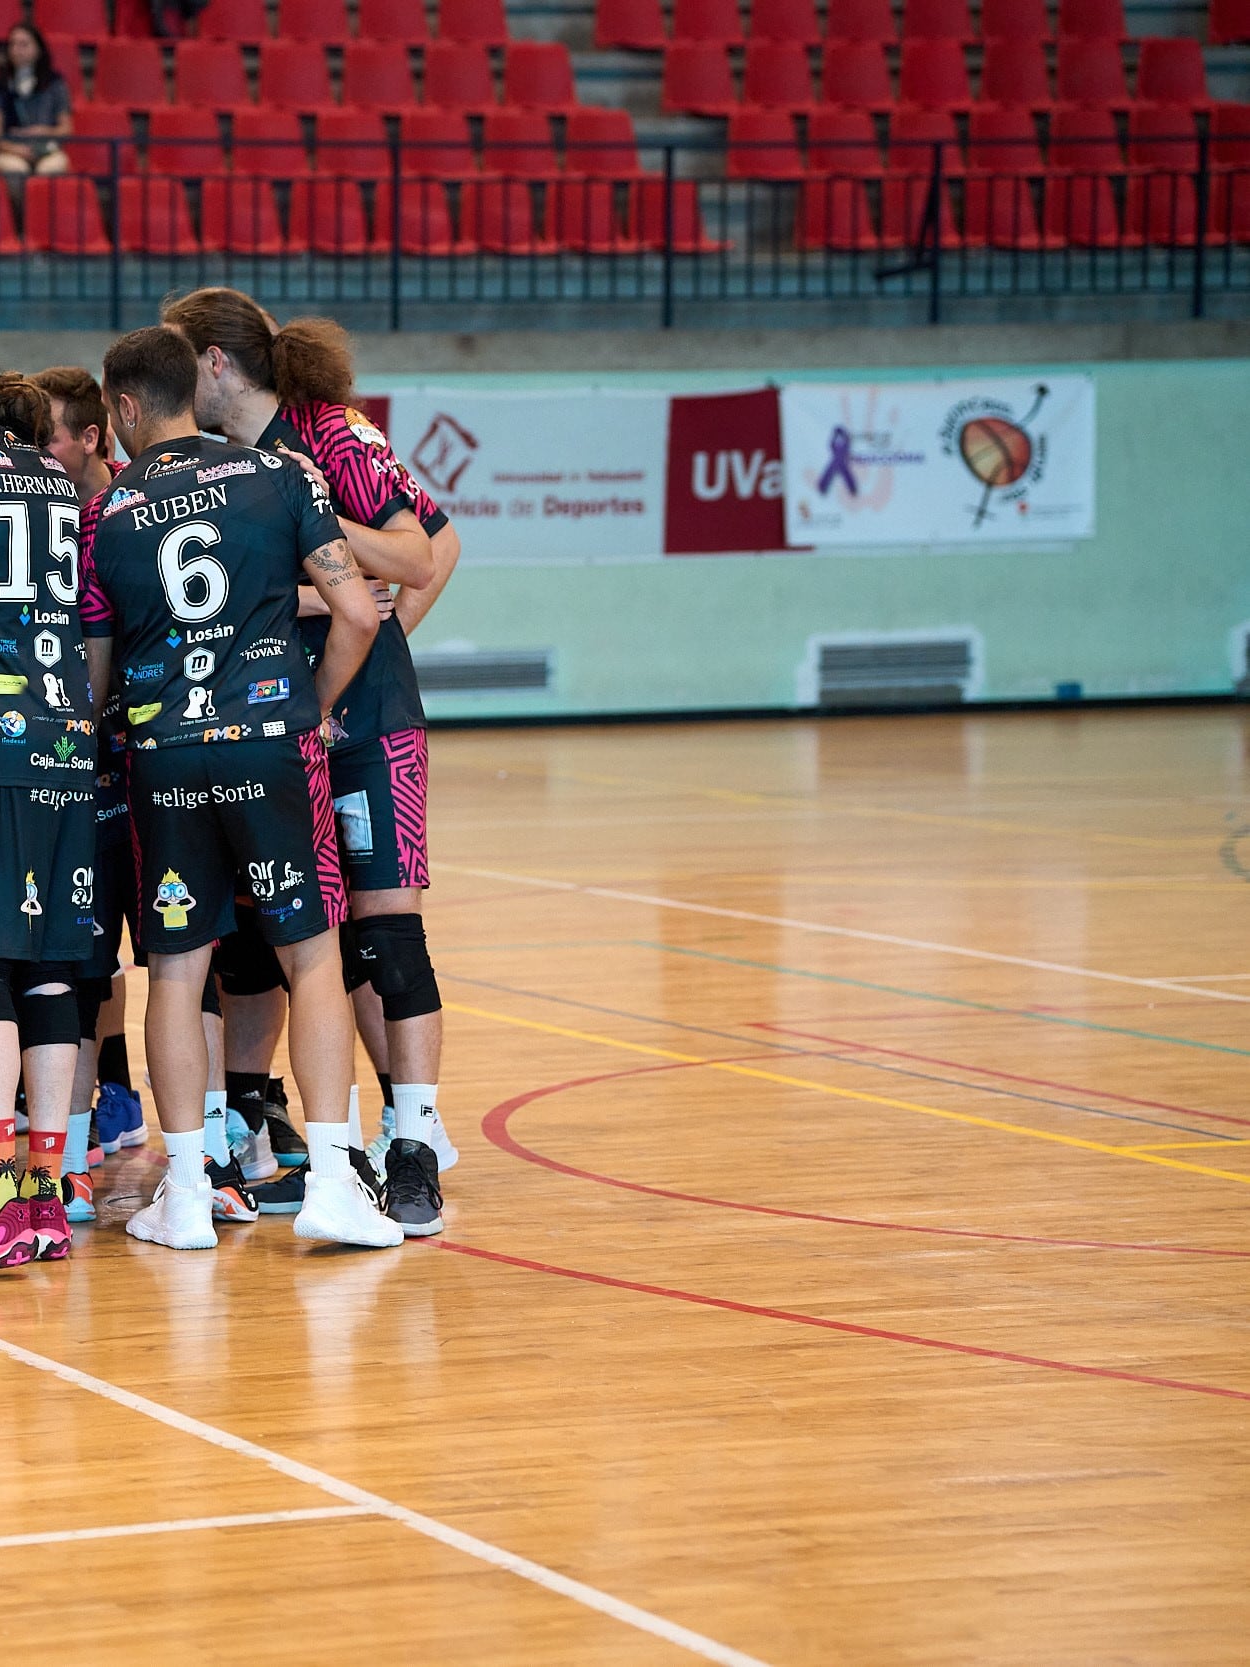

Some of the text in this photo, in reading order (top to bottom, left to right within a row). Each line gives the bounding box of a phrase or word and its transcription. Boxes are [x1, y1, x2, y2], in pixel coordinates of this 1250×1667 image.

[693, 449, 783, 500] UVa
[131, 484, 229, 531] RUBEN
[157, 520, 230, 624] 6
[34, 609, 69, 625] Losán
[186, 624, 234, 644] Losán
[245, 646, 284, 660] TOVAR
[132, 668, 164, 680] ANDRES
[66, 719, 91, 736] PMQ
[203, 724, 241, 743] PMQ
[30, 753, 54, 770] Caja
[71, 756, 94, 771] Soria
[152, 780, 266, 809] #elige Soria
